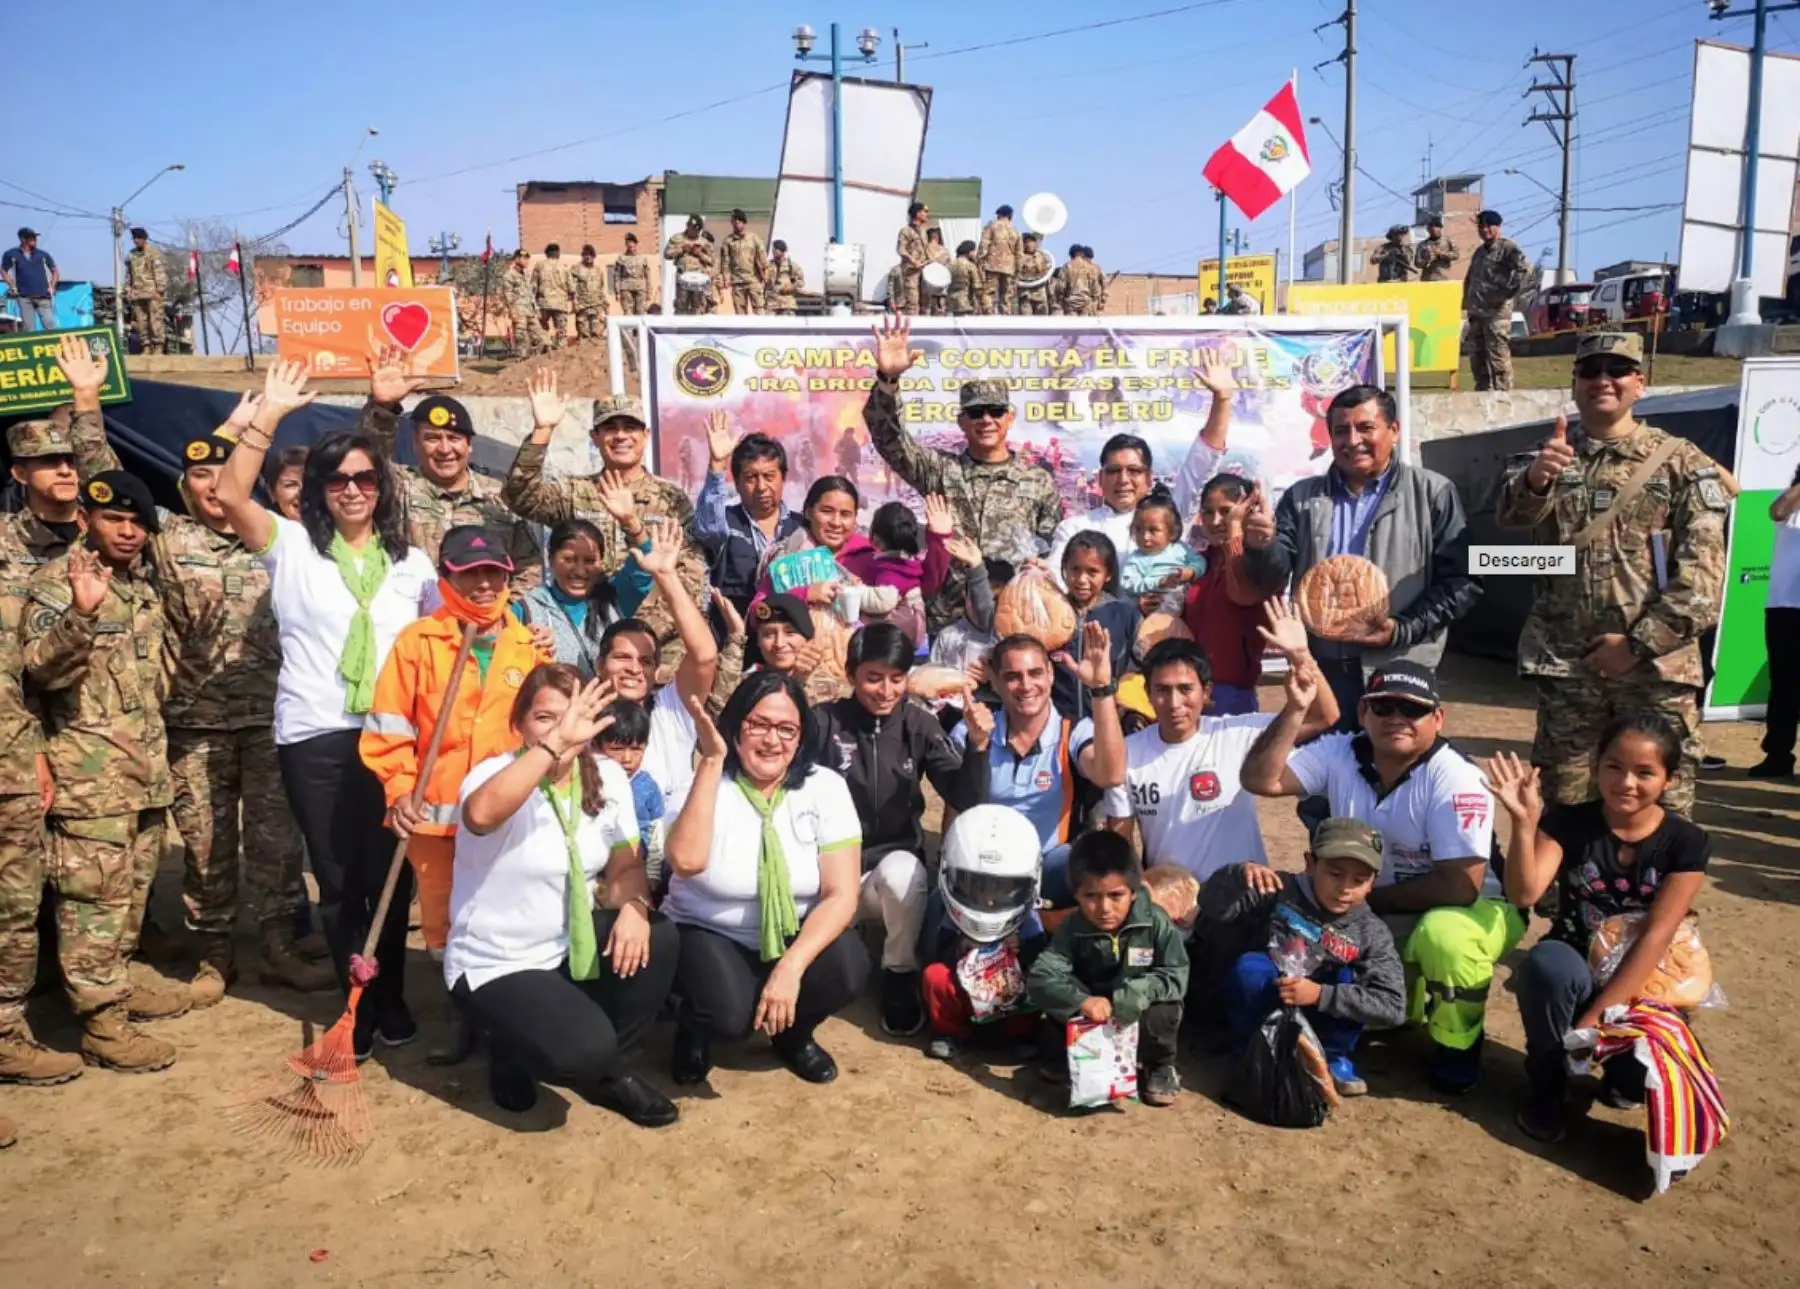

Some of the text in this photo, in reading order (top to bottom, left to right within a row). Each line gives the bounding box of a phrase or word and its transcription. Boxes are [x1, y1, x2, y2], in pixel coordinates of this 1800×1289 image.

[281, 295, 372, 315] Trabajo en
[283, 317, 342, 336] Equipo
[756, 347, 1268, 369] CAMPAA CONTRA EL FRIJE
[747, 376, 801, 391] 1RA
[808, 376, 935, 391] BRIGDA
[990, 376, 1115, 391] UERZAS
[1025, 401, 1083, 421] DEL
[1092, 396, 1173, 421] PERÚ
